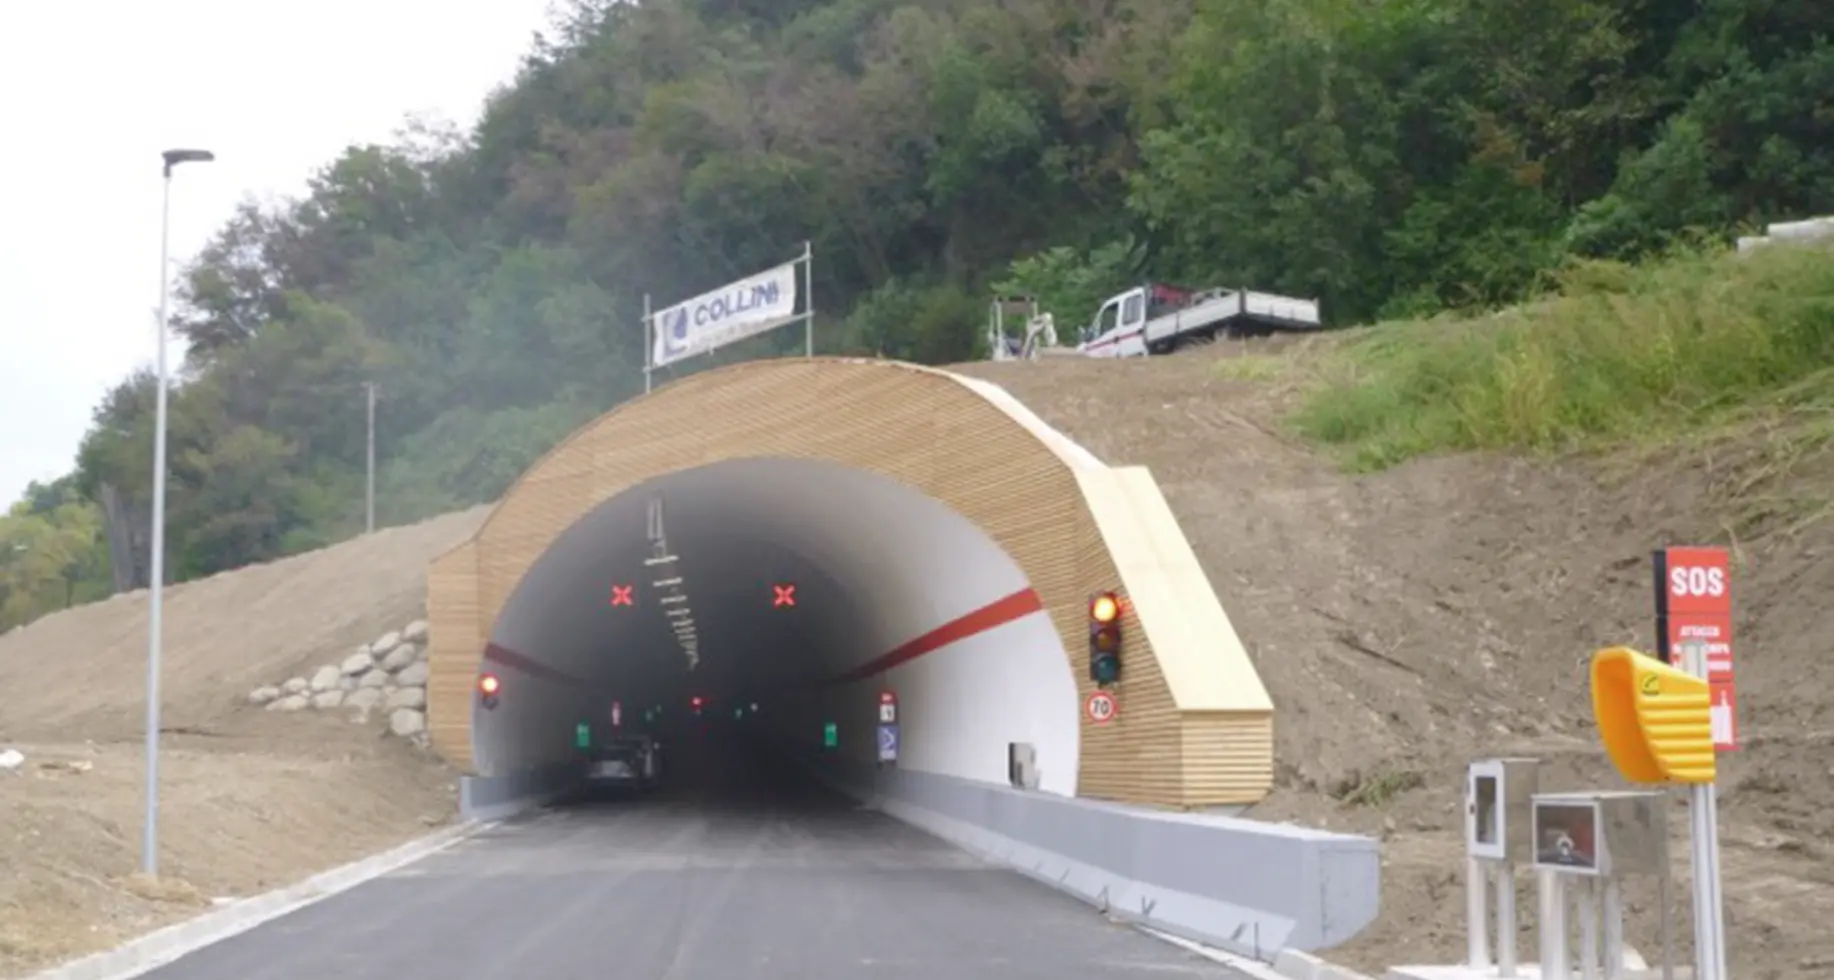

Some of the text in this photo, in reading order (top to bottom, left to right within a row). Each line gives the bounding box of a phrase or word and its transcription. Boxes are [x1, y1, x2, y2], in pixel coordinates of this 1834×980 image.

[694, 280, 779, 326] COLLINI
[1671, 567, 1724, 597] SOS
[1094, 700, 1109, 715] 70
